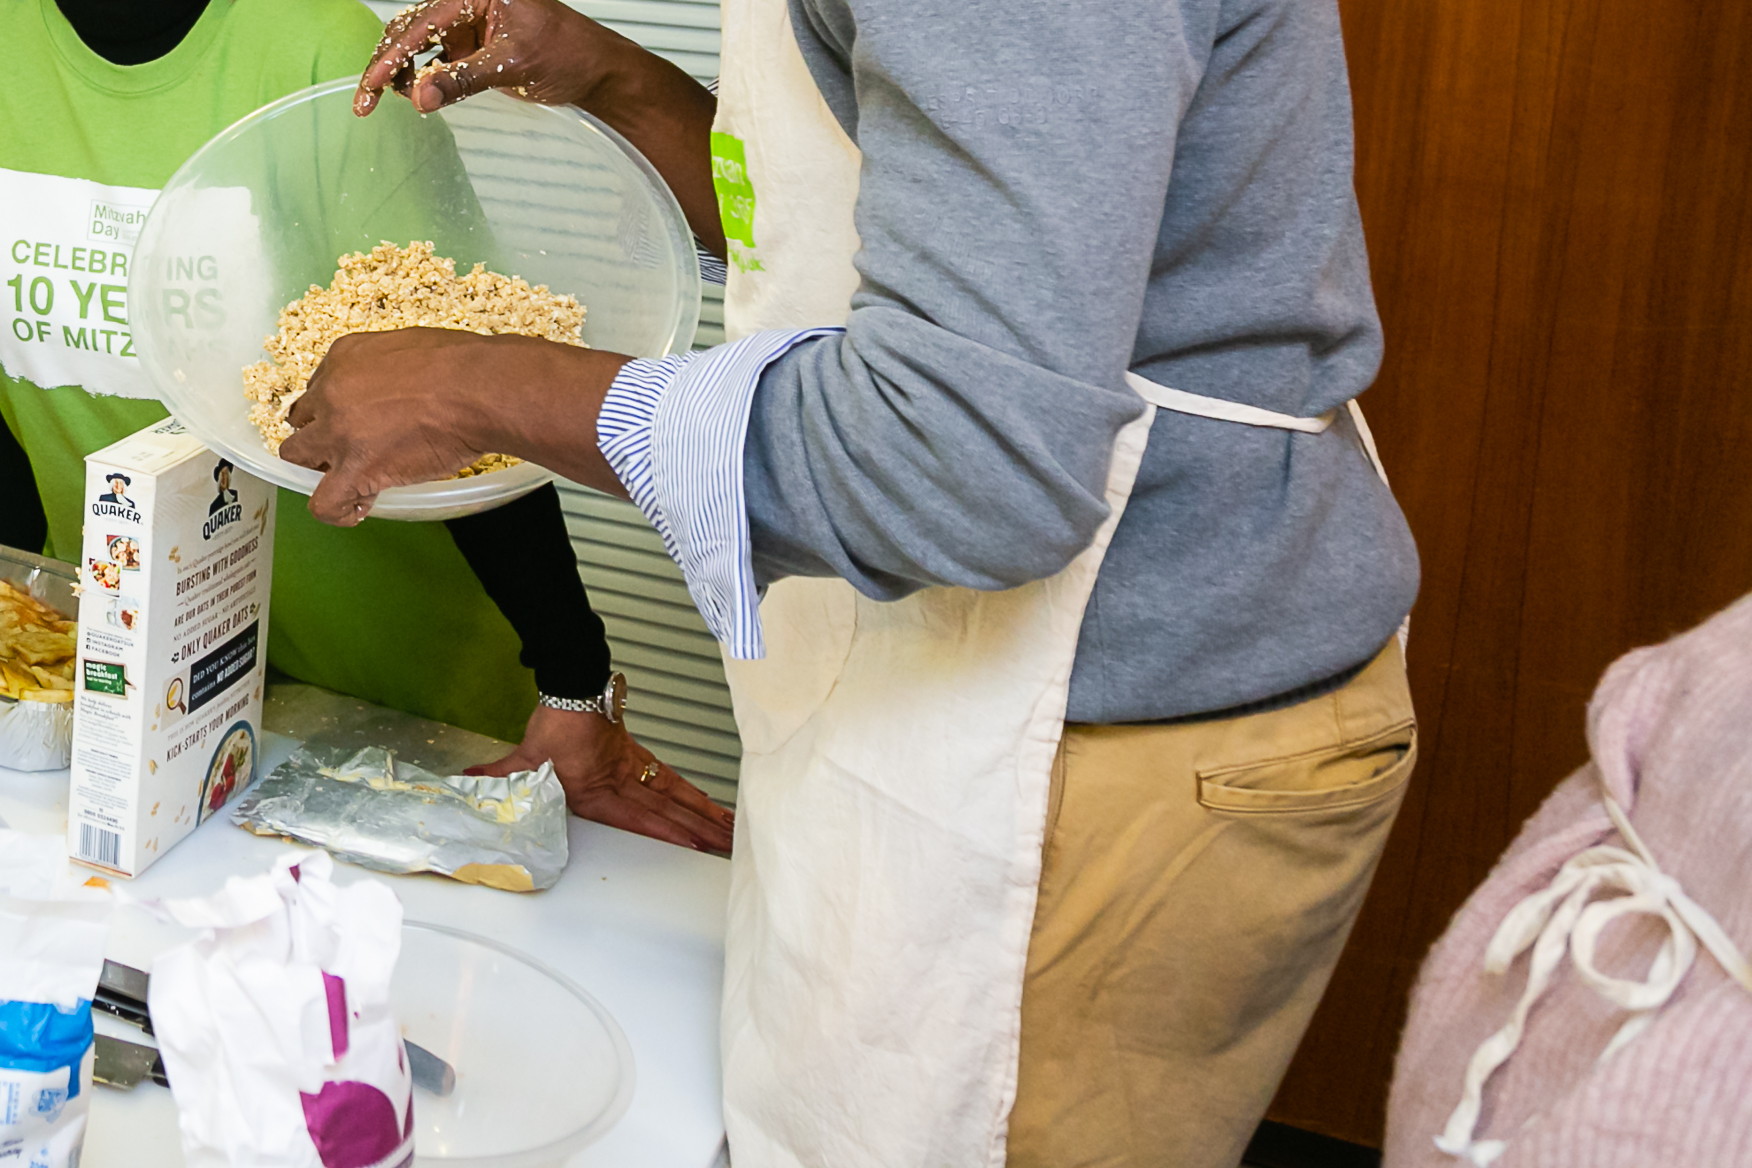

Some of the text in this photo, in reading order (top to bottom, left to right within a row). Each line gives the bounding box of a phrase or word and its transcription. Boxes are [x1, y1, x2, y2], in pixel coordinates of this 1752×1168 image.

[94, 204, 147, 225] Mitzvah
[92, 220, 120, 239] Day
[7, 273, 55, 316] 10
[12, 317, 52, 343] OF
[92, 502, 142, 526] QUAKER
[202, 503, 243, 541] QUAKER
[176, 565, 211, 597] BURSTING
[212, 555, 229, 576] WITH
[174, 614, 185, 628] ARE
[185, 608, 196, 622] OUR
[197, 600, 210, 618] OATS
[181, 605, 249, 661] ONLY QUAKER OATS
[91, 639, 124, 652] INSTAGRAM
[91, 646, 121, 658] FACEBOOK
[85, 662, 107, 672] magic
[85, 668, 118, 681] breakfast
[192, 670, 205, 685] DID
[206, 661, 219, 675] YOU
[166, 724, 208, 762] KICK-STARTS
[208, 713, 224, 734] YOUR
[224, 693, 250, 722] MORNING
